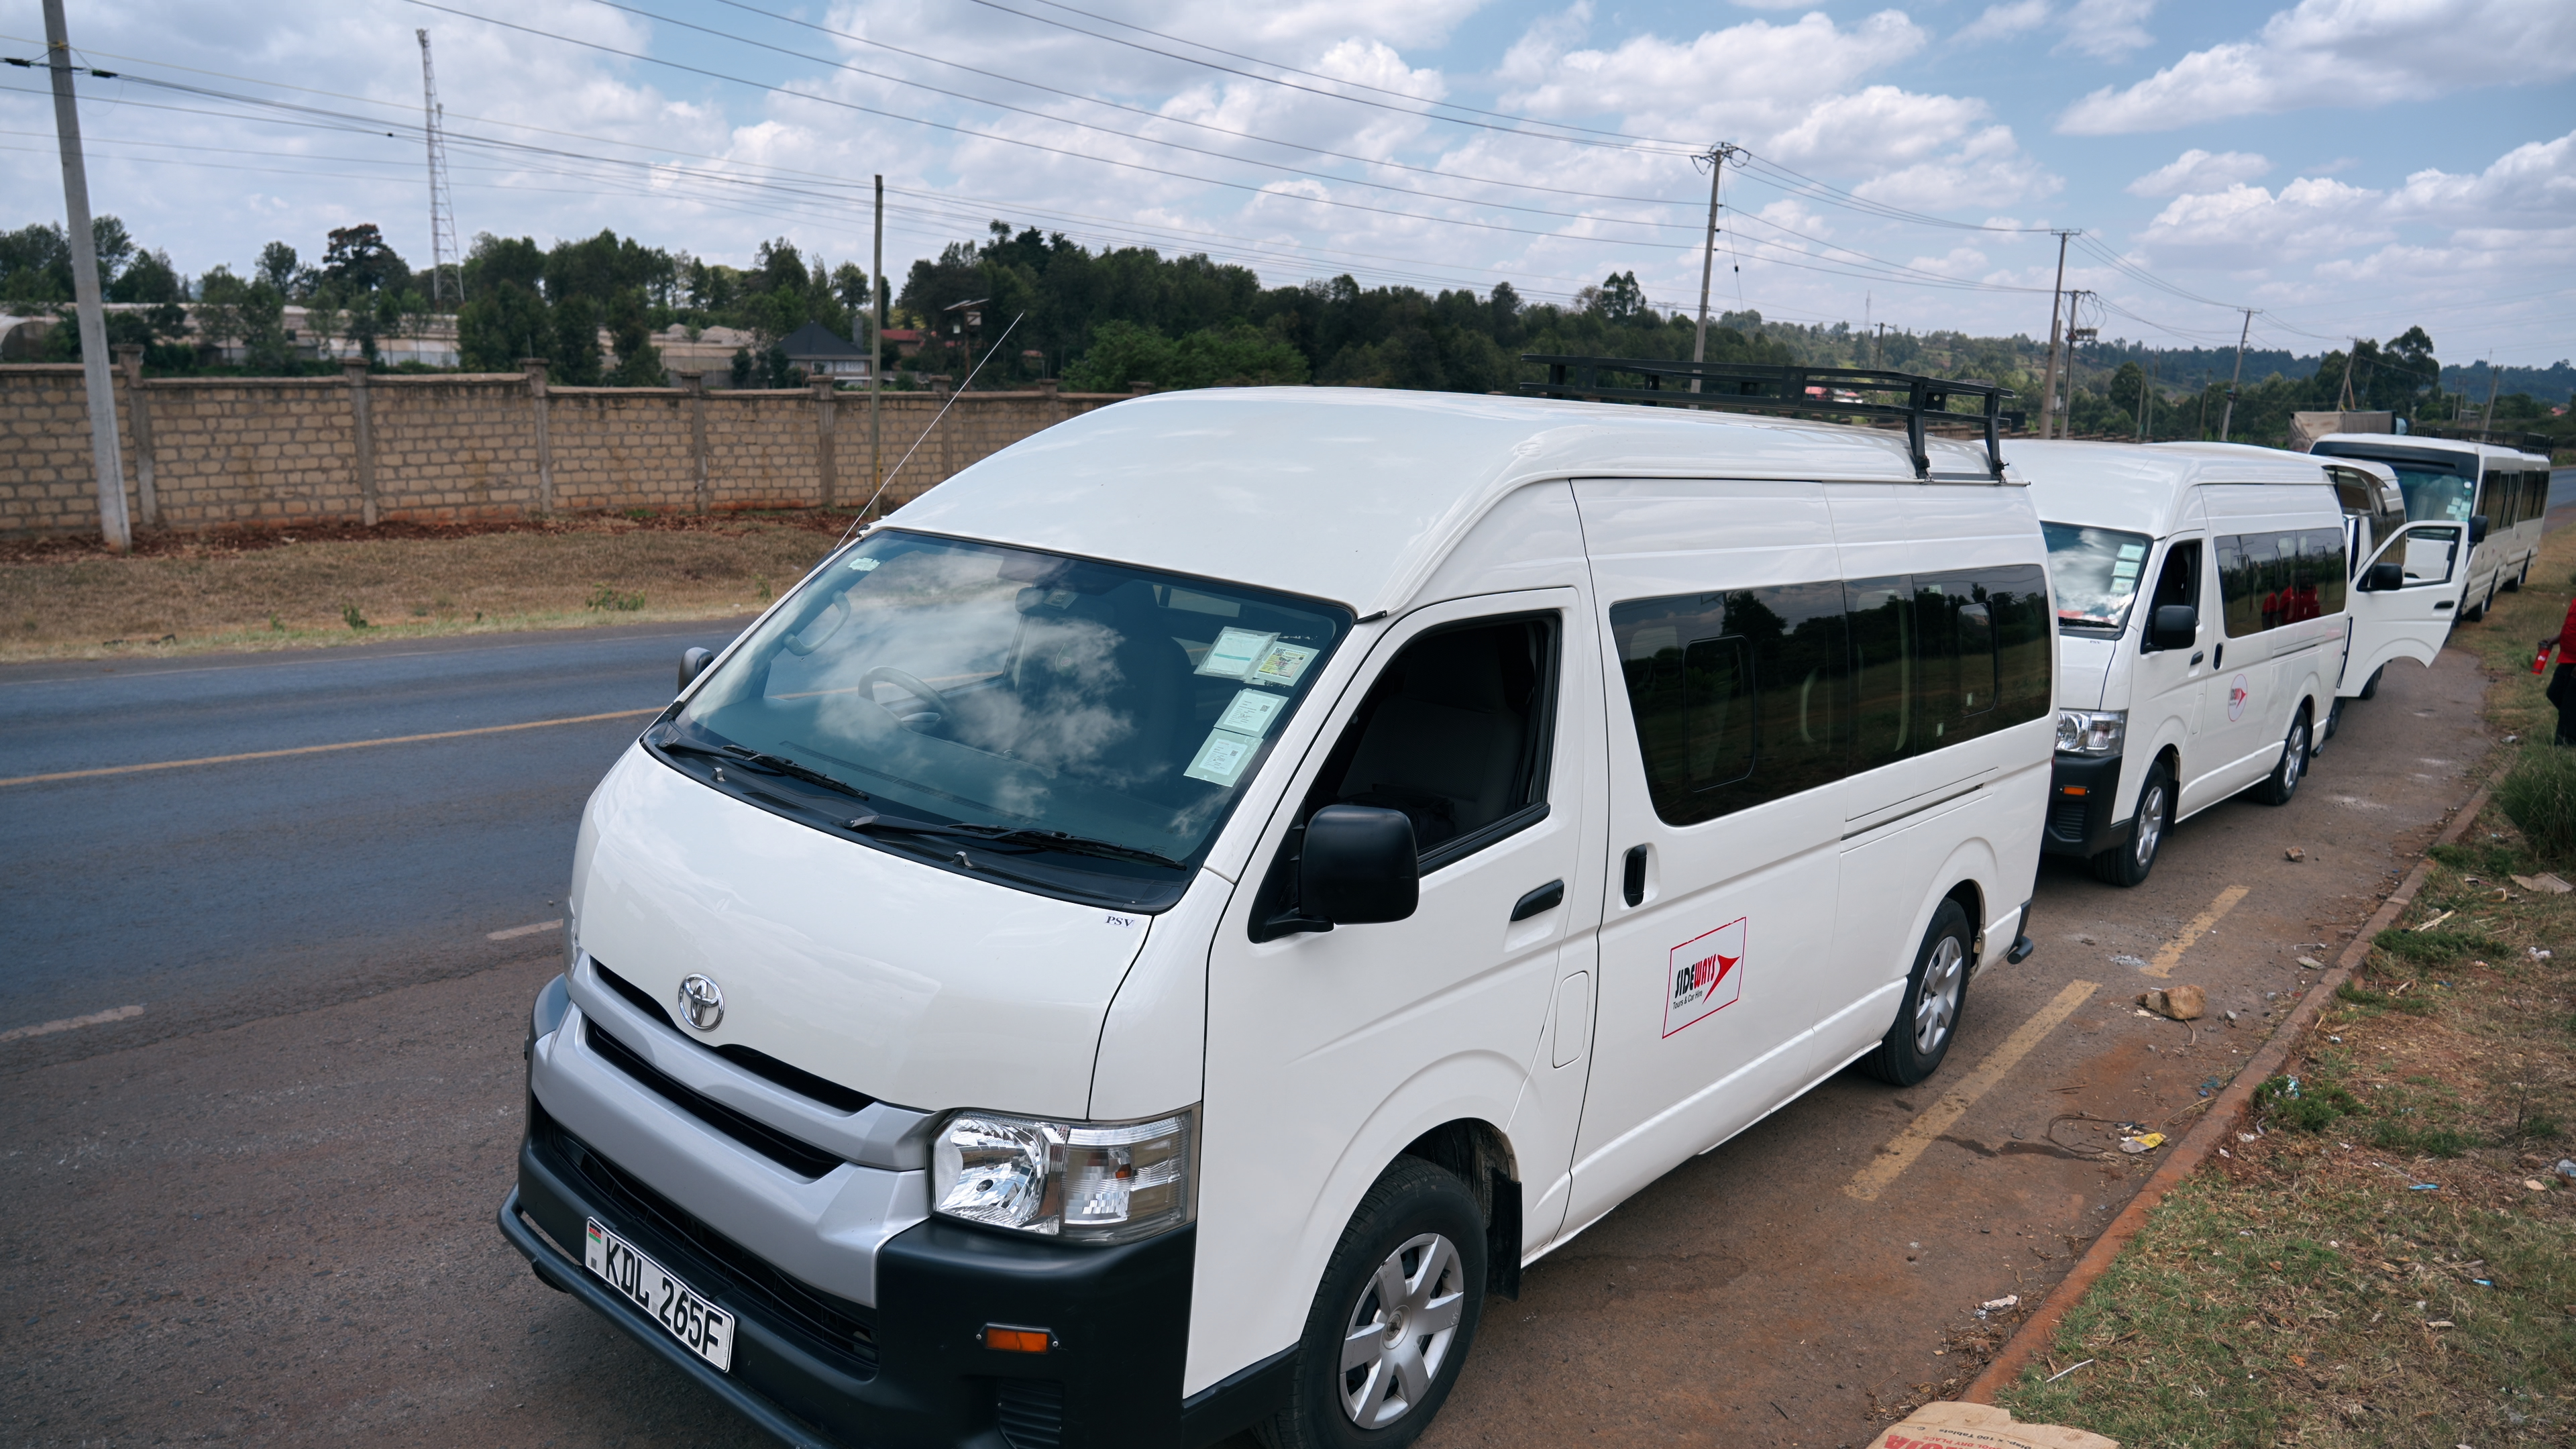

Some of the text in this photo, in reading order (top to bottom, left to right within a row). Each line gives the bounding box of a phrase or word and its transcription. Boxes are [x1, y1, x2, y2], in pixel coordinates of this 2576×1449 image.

[1106, 916, 1134, 927] PSV
[1674, 953, 1717, 999] SIDEWAYS
[1672, 999, 1684, 1010] Tours
[1684, 996, 1688, 1004] &
[1695, 989, 1703, 999] Hire
[606, 1236, 722, 1356] KDL 265F
[1922, 1436, 1953, 1444] PLACE
[1939, 1429, 1974, 1438] Tablets
